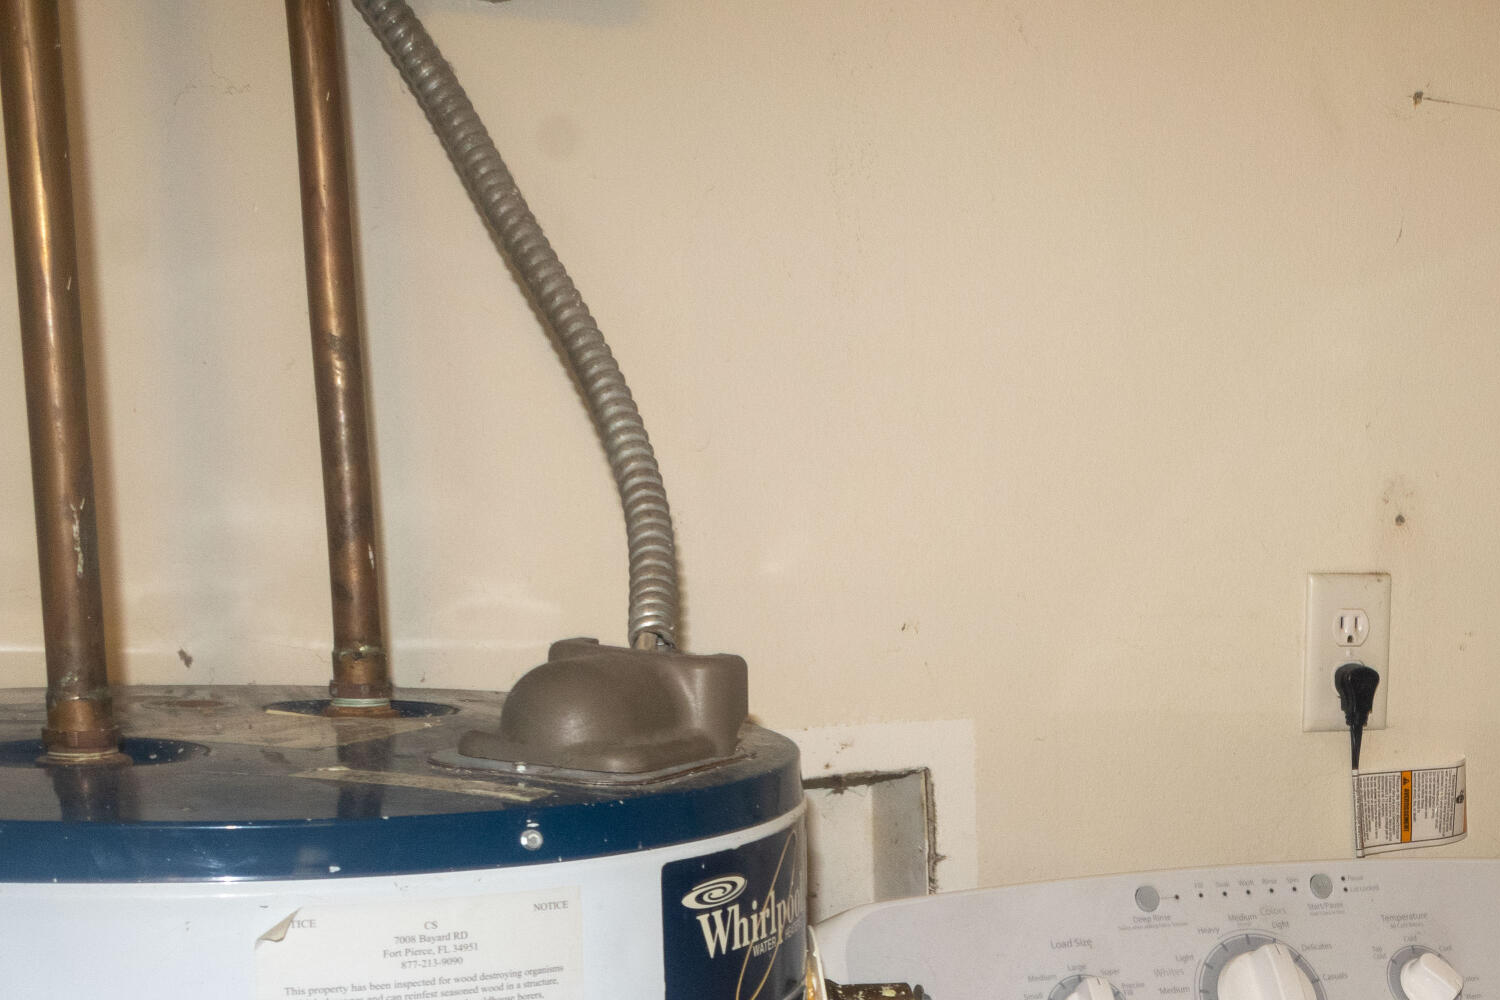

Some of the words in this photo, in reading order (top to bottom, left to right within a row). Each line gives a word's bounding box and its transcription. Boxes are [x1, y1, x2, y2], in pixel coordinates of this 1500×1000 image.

[532, 900, 569, 912] NOTICE
[424, 920, 439, 930] CS
[394, 935, 416, 945] 7008
[419, 932, 451, 944] Bayard
[453, 930, 469, 941] RD
[1050, 936, 1072, 950] Load
[1073, 937, 1093, 949] Size
[383, 949, 402, 959] Fort
[404, 946, 436, 958] Pierce,
[437, 944, 451, 954] FL
[753, 936, 777, 957] WATER
[285, 986, 306, 997] This
[307, 984, 348, 998] property
[351, 983, 368, 993] has
[370, 981, 392, 992] been
[394, 977, 437, 991] inspected
[438, 975, 452, 985] for
[453, 973, 478, 984] wood
[480, 969, 523, 983] destroying
[524, 964, 564, 978] organisms
[404, 990, 438, 1000] reinfest
[440, 986, 479, 998] seasoned
[480, 983, 504, 993] wood
[506, 980, 515, 991] in
